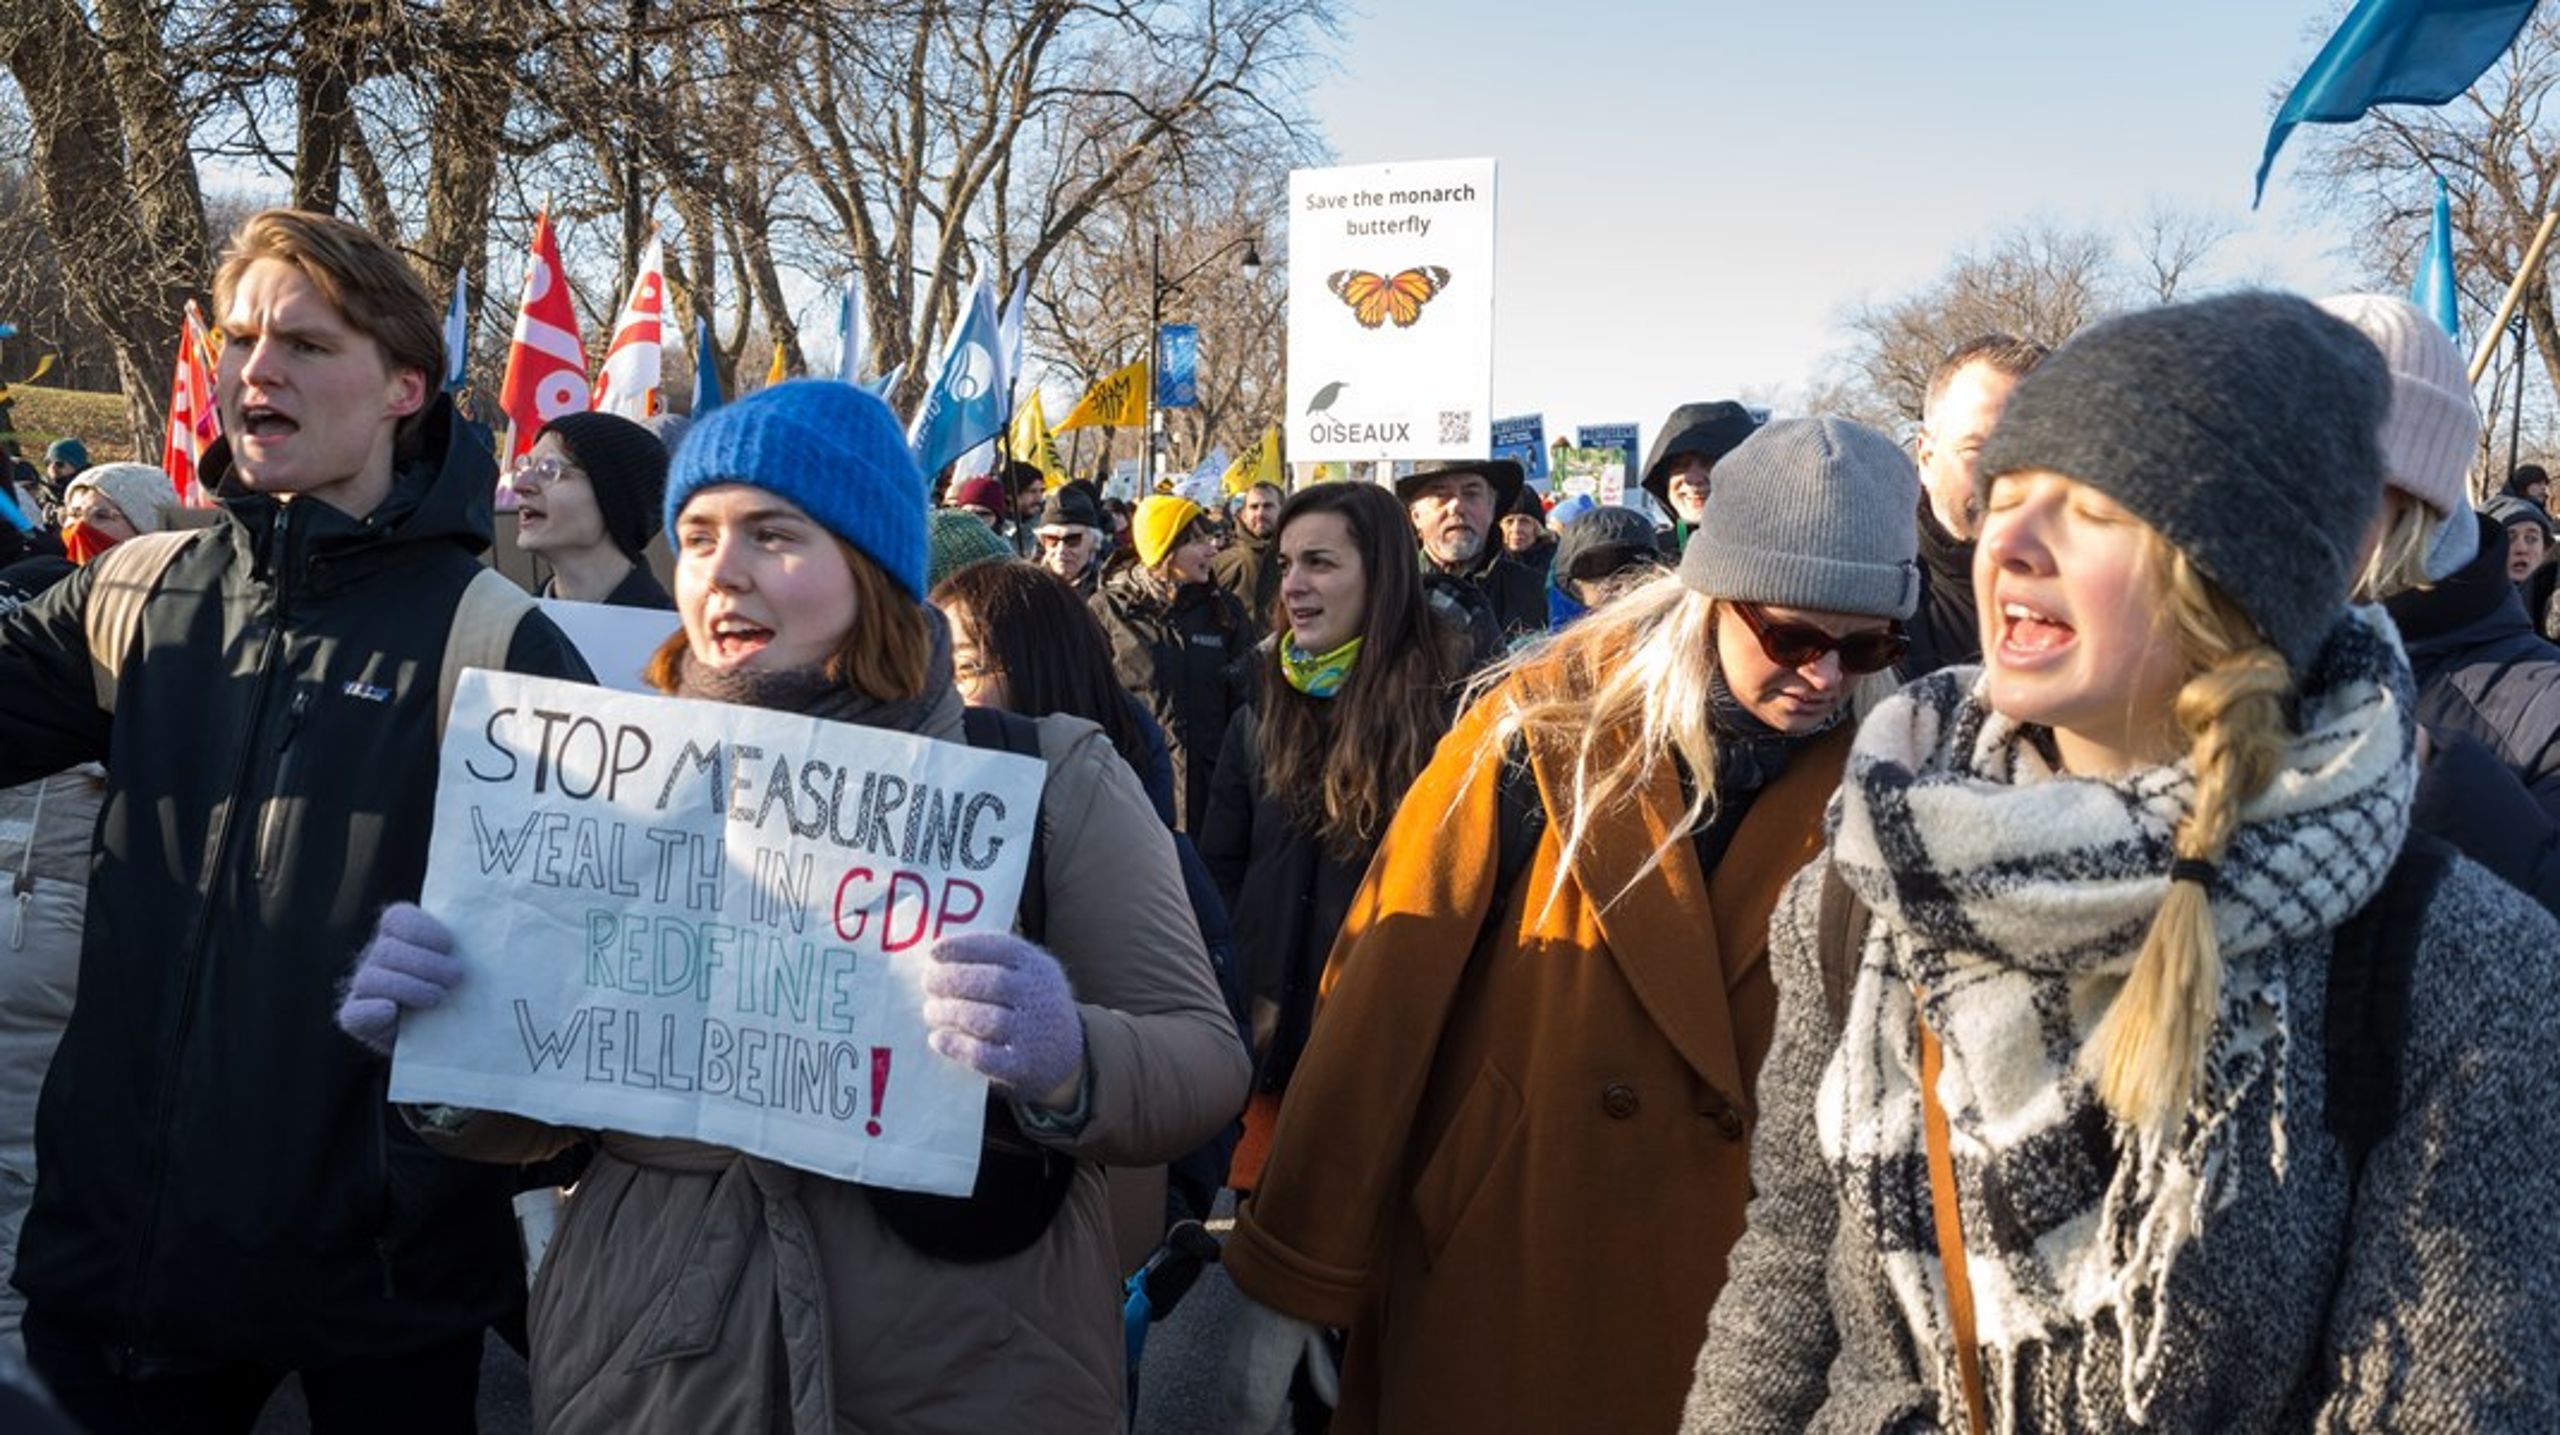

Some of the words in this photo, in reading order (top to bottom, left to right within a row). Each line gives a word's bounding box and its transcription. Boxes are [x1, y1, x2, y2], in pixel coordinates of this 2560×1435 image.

[1306, 192, 1347, 211] Save
[1353, 190, 1383, 207] the
[1389, 184, 1475, 204] monarch
[1346, 214, 1431, 237] butterfly
[1310, 423, 1410, 443] OISEAUX
[466, 706, 652, 802] STOP
[656, 739, 1006, 872] MEASURING
[469, 806, 726, 912] WEALTH
[750, 847, 813, 934] IN
[833, 867, 985, 953] GDP
[584, 909, 857, 1034] REDFINE
[513, 999, 893, 1138] WELLBEING!
